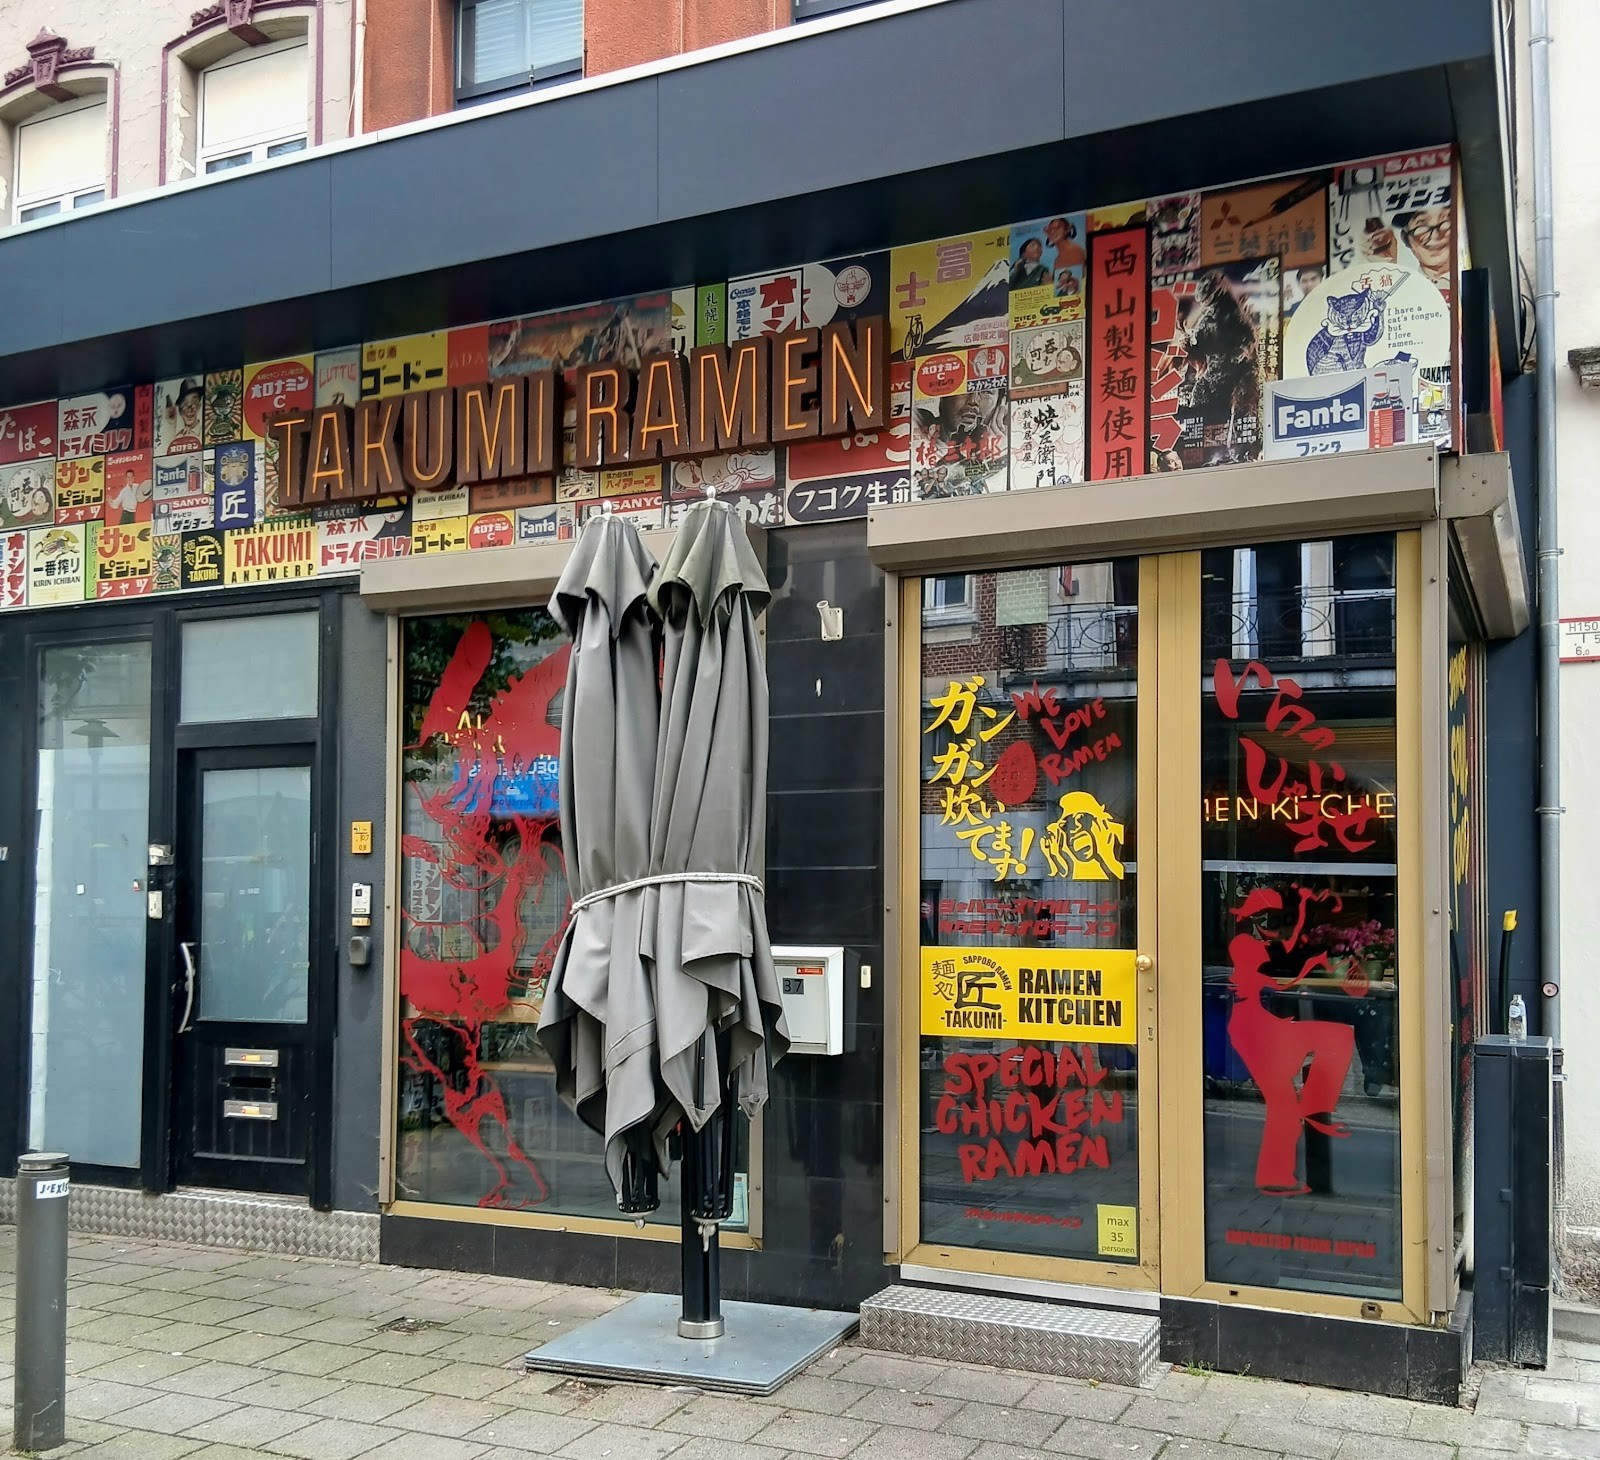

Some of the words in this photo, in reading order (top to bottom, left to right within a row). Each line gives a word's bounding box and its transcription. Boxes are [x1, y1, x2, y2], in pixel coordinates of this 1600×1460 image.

[269, 368, 563, 510] TAKUMI
[576, 318, 893, 472] RAMEN
[1277, 398, 1361, 437] Fanta
[157, 468, 186, 485] Fanta
[171, 495, 209, 509] SANYO
[219, 489, 250, 522] 匠
[520, 518, 556, 538] Fanta
[233, 530, 312, 568] TAKUMI
[33, 578, 52, 588] KIRIN
[53, 575, 81, 586] ICHIBAN
[231, 563, 314, 584] ANTWERP
[1010, 678, 1062, 721] WE
[1040, 696, 1107, 750] LOVE
[784, 979, 803, 993] 37
[962, 955, 997, 970] SAPPORO
[994, 965, 1013, 991] RAMEN
[1018, 967, 1102, 997] RAMEN
[953, 970, 1002, 1011] 匠
[1018, 997, 1122, 1027] KITCHEN
[943, 1045, 1108, 1098] SPECIAL
[935, 1087, 1124, 1139] CHICKEN
[957, 1131, 1110, 1185] RAMEN
[1106, 1216, 1130, 1227] max
[1101, 1245, 1135, 1255] personen
[1110, 1232, 1124, 1243] 35
